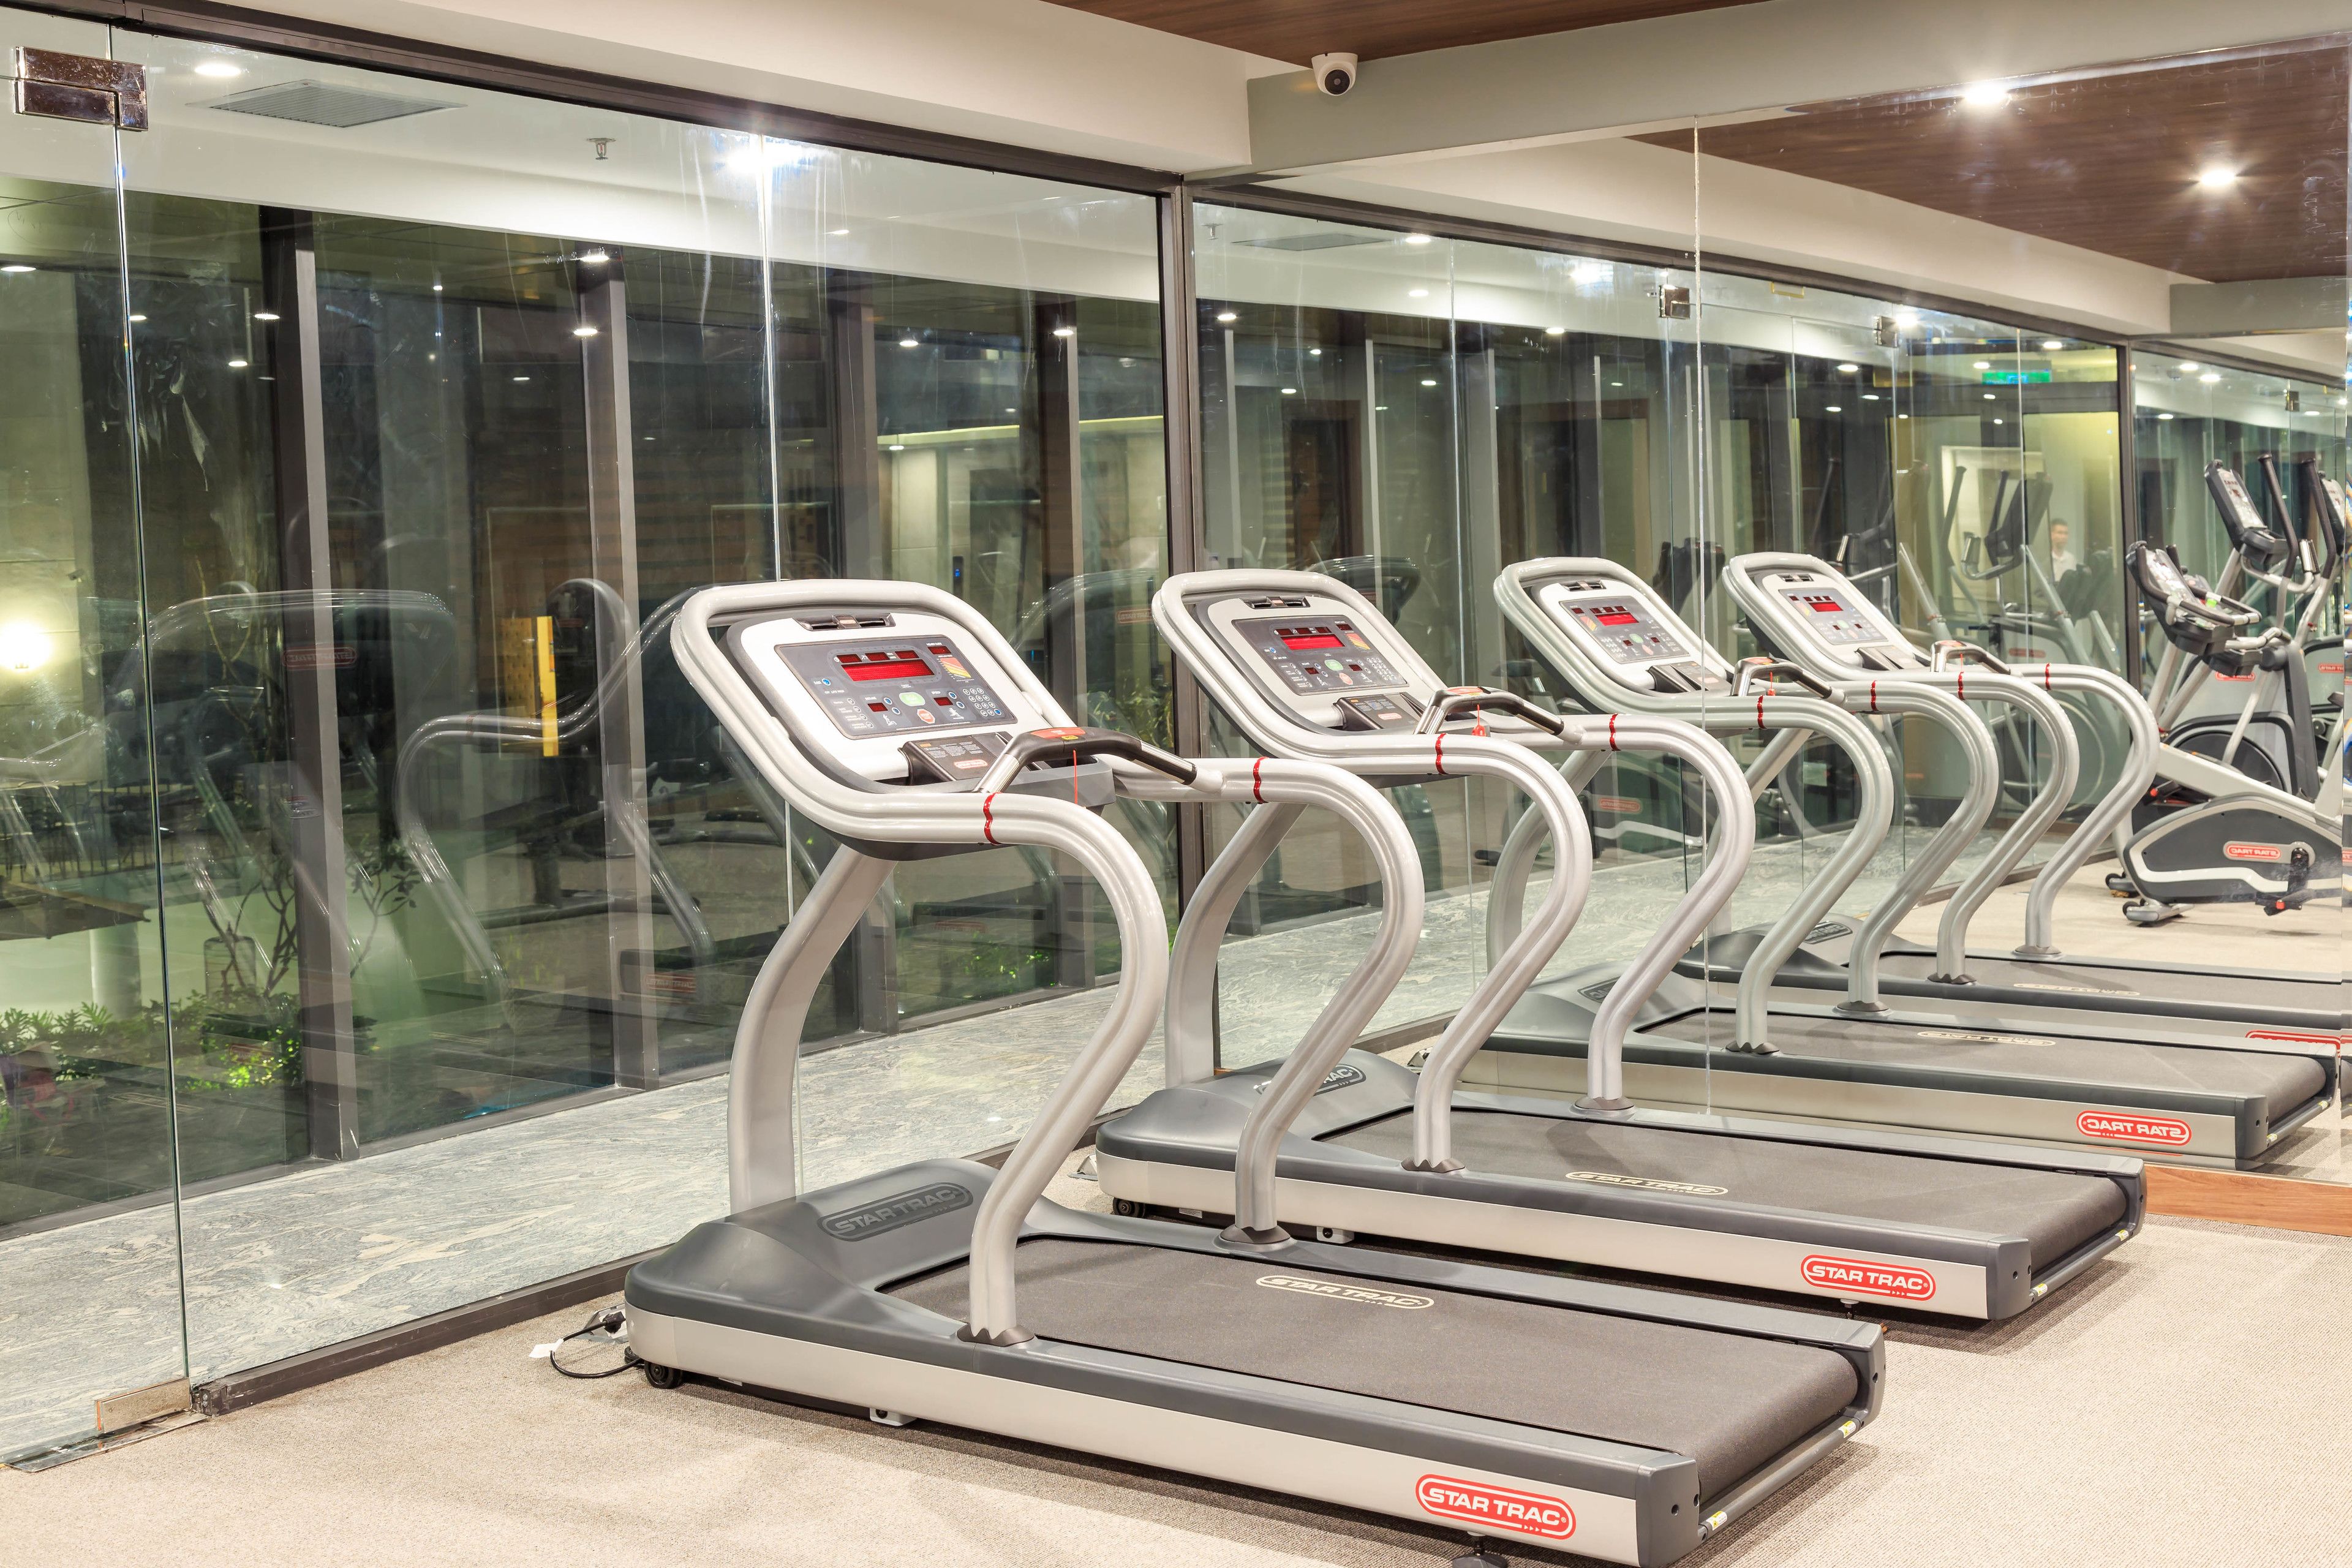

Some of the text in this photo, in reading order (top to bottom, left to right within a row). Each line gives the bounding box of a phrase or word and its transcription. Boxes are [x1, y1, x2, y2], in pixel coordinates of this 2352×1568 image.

[1578, 1174, 1717, 1193] STAR TRAC
[835, 1189, 956, 1234] STAR TRAC
[1270, 1278, 1422, 1306] STAR TRAC
[1812, 1265, 1923, 1291] STAR TRAC
[1428, 1487, 1561, 1526] STAR TRAC
